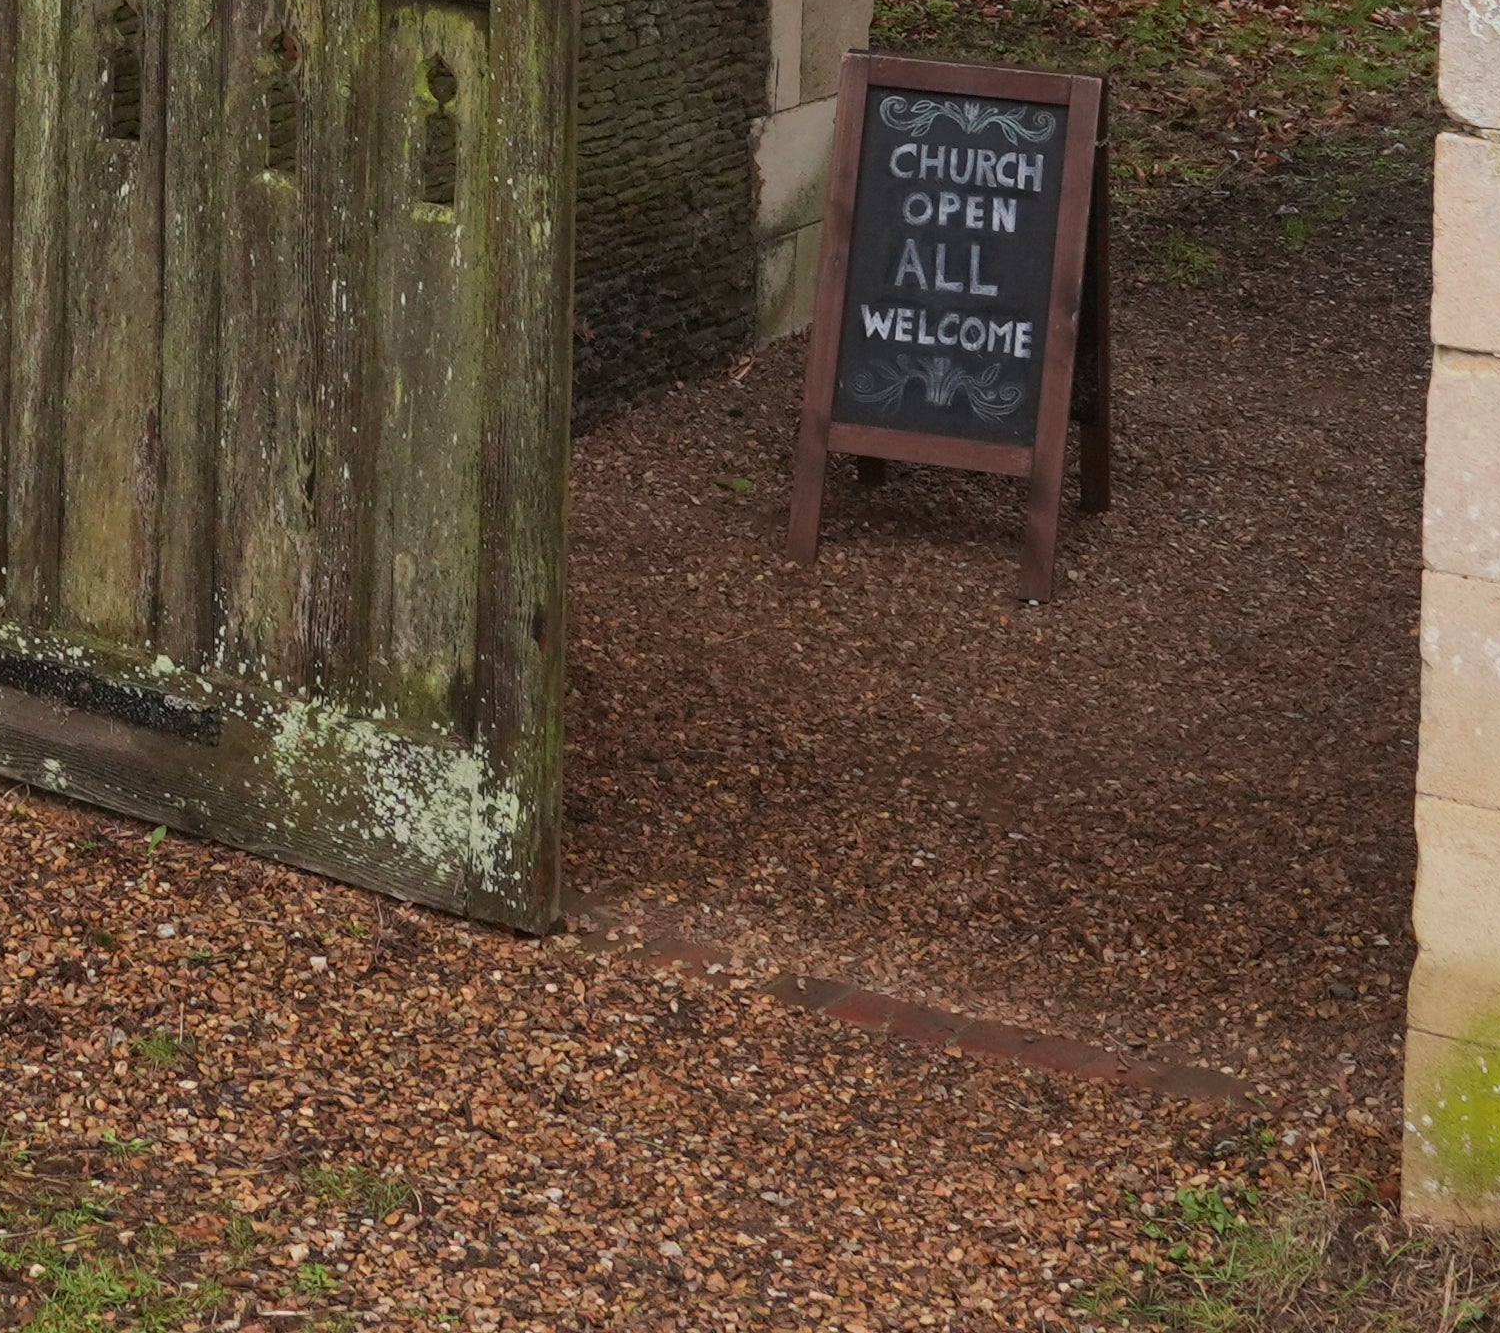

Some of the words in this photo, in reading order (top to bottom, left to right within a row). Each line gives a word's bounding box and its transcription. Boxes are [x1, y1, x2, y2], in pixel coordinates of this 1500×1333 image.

[889, 143, 1044, 192] CHURCH
[903, 192, 1017, 233] OPEN
[894, 238, 998, 297] ALL
[861, 304, 1033, 358] WELCOME
